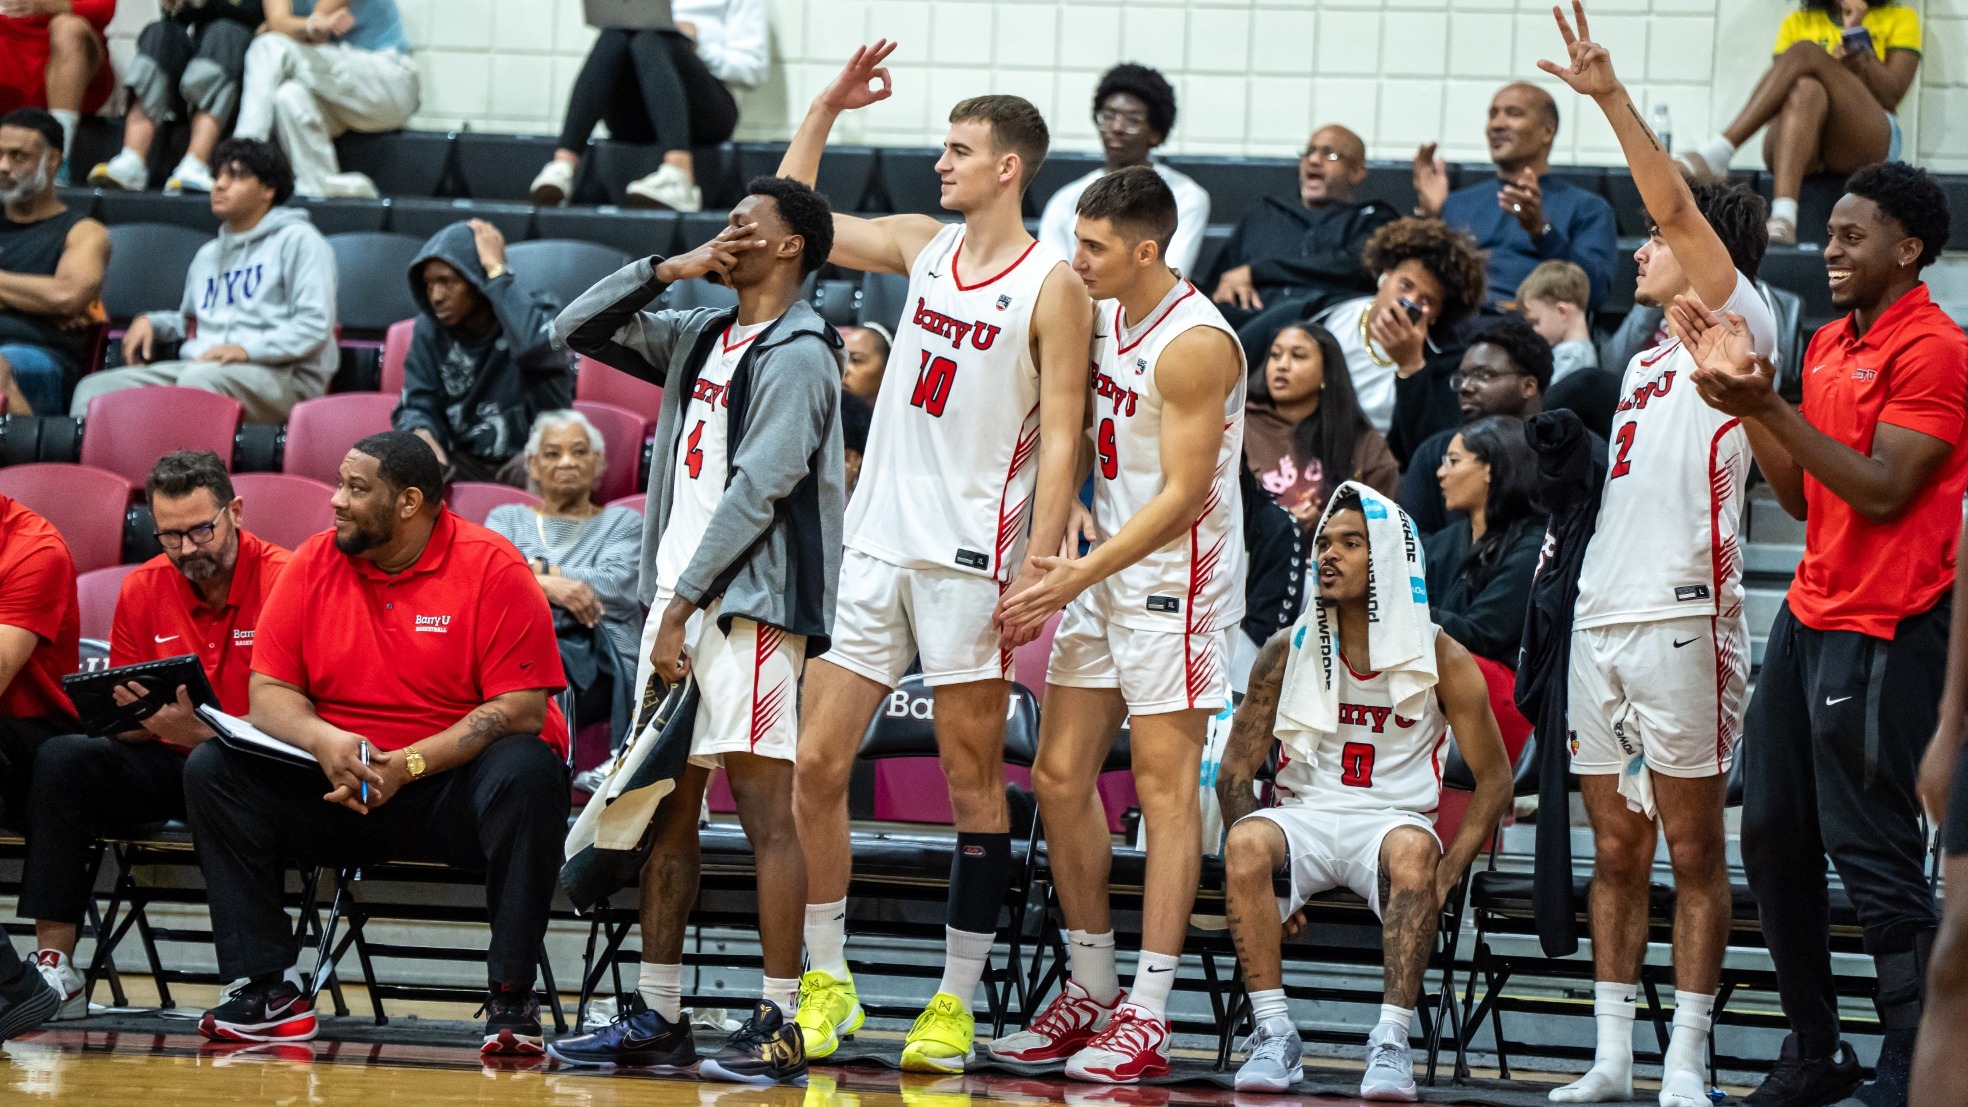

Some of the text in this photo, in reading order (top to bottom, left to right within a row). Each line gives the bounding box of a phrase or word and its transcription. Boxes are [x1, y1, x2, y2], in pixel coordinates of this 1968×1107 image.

[201, 264, 262, 309] NYU
[913, 297, 1001, 350] Barry U
[910, 349, 957, 418] 10
[684, 419, 706, 480] 4
[1098, 418, 1118, 480] 9
[1611, 421, 1637, 480] 2
[233, 629, 256, 638] Barr
[415, 614, 451, 626] Barry U
[1339, 703, 1392, 733] rry
[1341, 742, 1375, 788] 0
